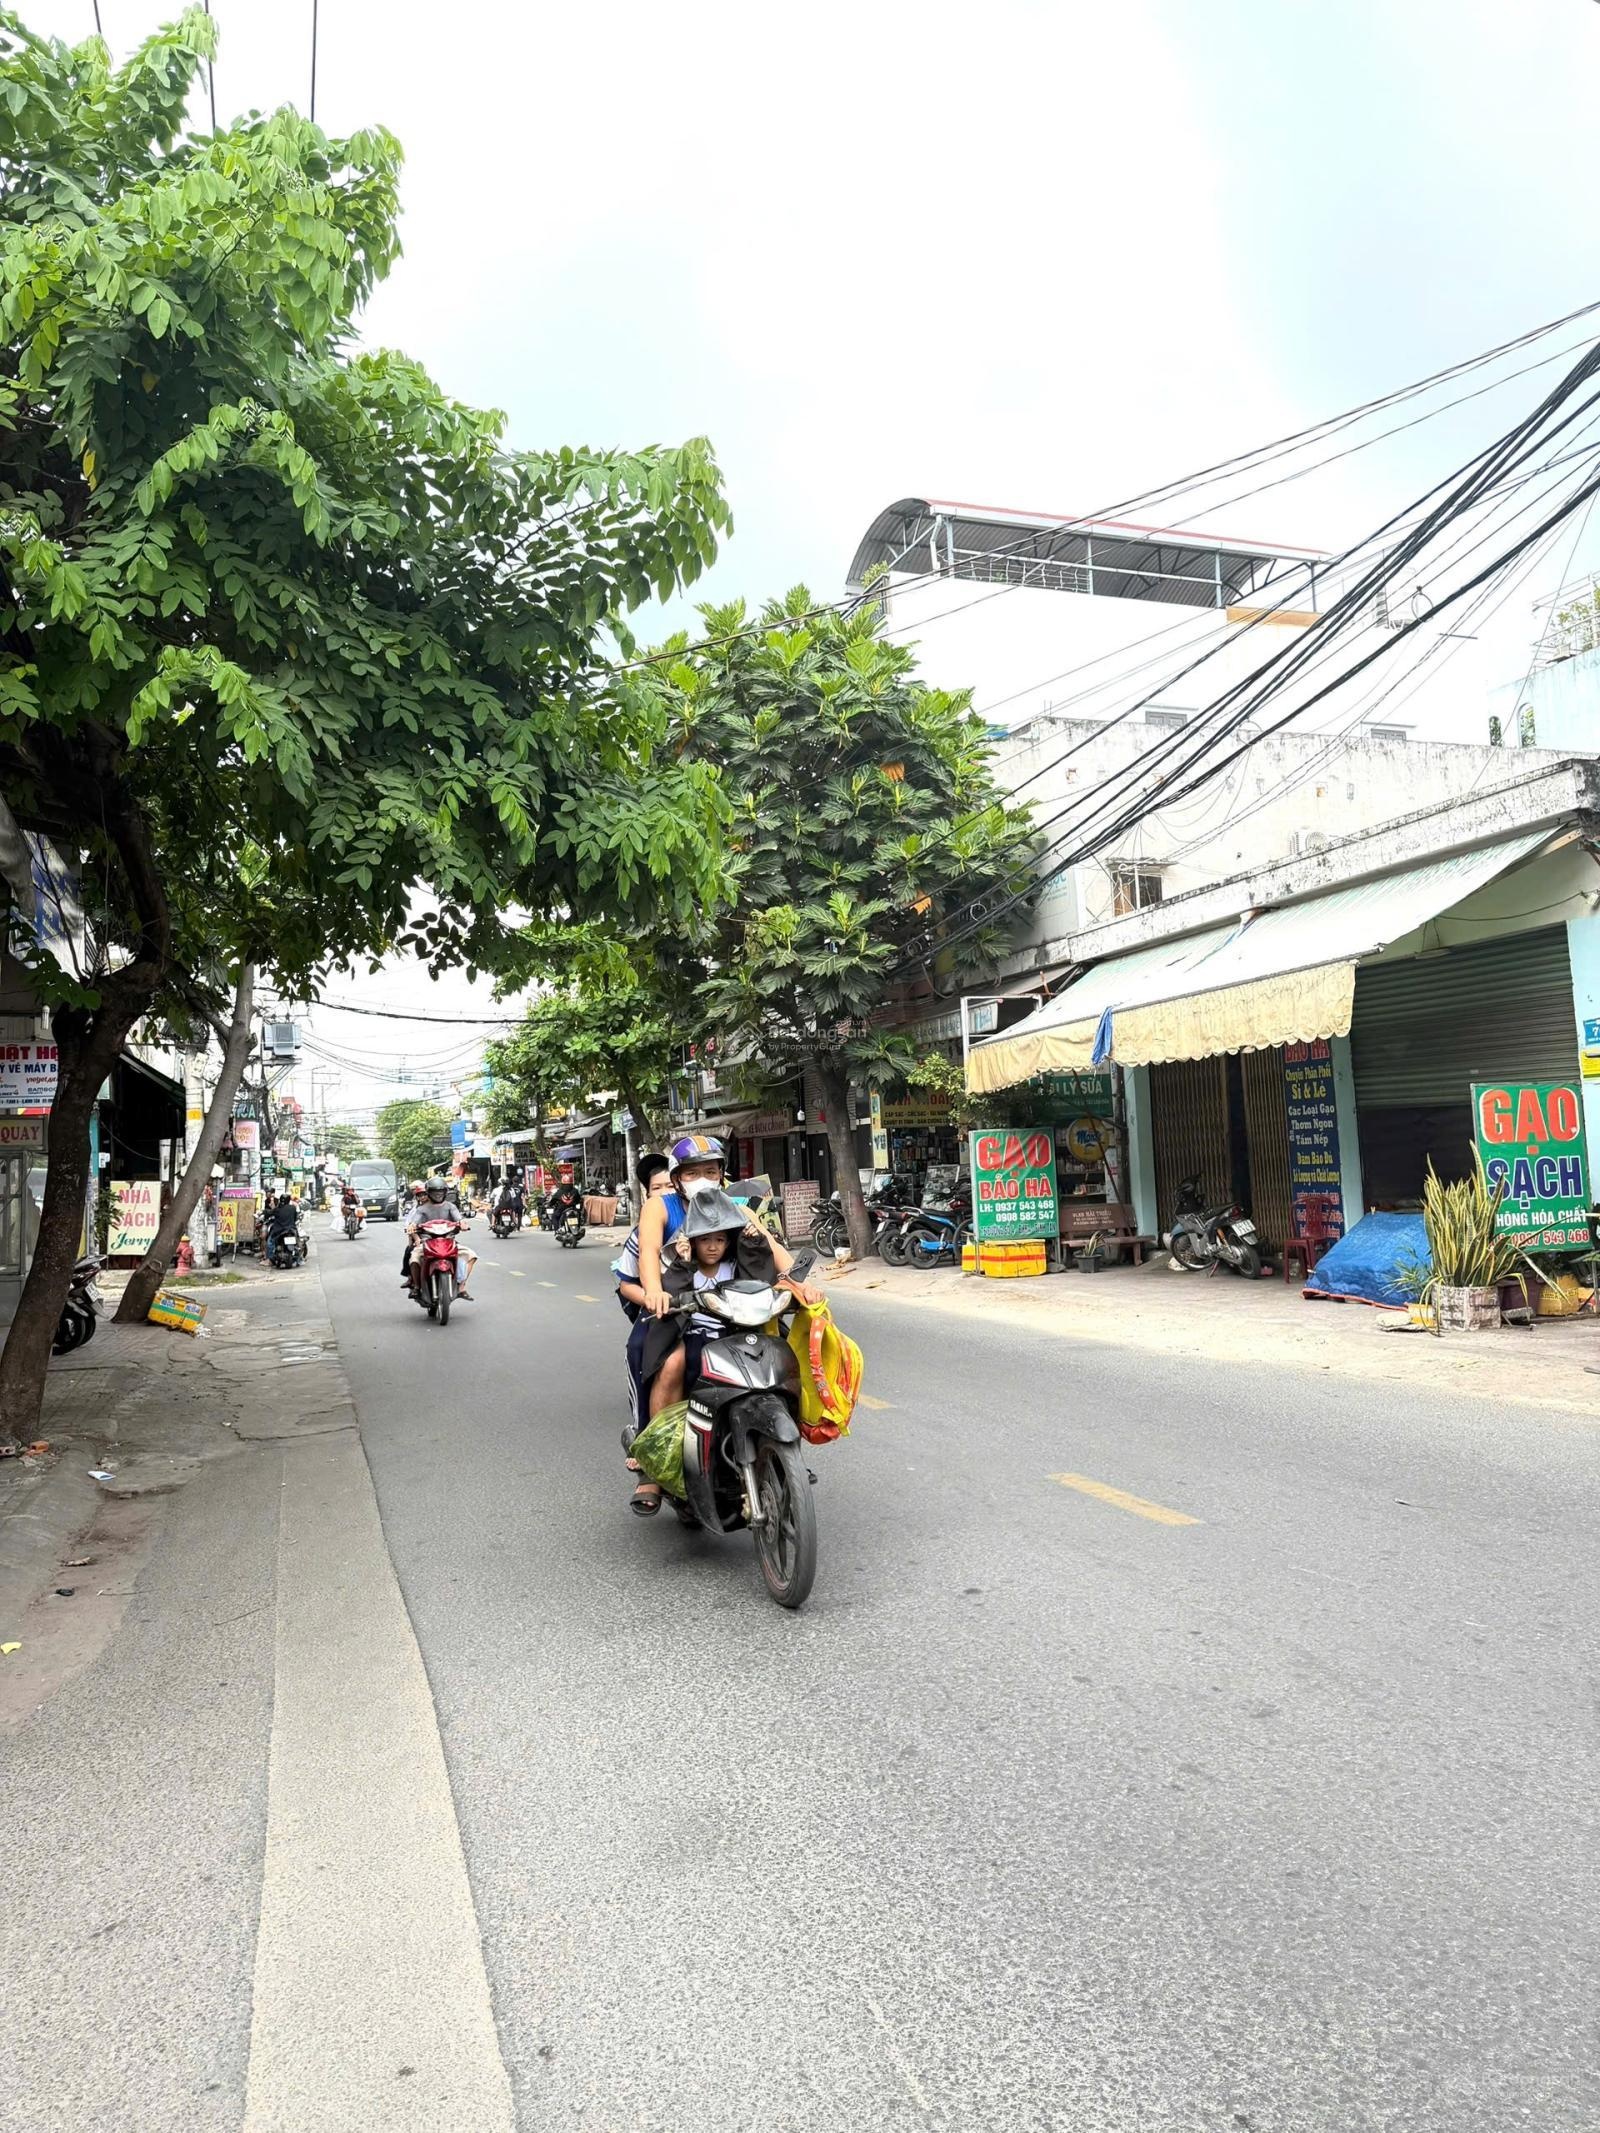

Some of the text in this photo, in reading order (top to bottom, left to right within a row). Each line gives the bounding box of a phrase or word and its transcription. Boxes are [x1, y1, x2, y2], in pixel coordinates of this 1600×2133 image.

[1313, 1118, 1334, 1131] Ngon
[1479, 1088, 1580, 1155] GẠO
[0, 1126, 40, 1144] QUAY
[976, 1132, 1052, 1178] GẠO
[979, 1173, 1053, 1201] BẢO HÀ
[1486, 1155, 1584, 1209] SẠCH
[118, 1186, 151, 1204] NHÀ
[995, 1202, 1017, 1212] 0937
[1019, 1200, 1036, 1211] 543
[1038, 1200, 1054, 1209] 468
[996, 1210, 1055, 1222] 0908 582 547
[1496, 1211, 1528, 1227] HÔNG
[1531, 1209, 1555, 1225] HÓA
[1543, 1229, 1565, 1246] 543
[1568, 1228, 1590, 1243] 468
